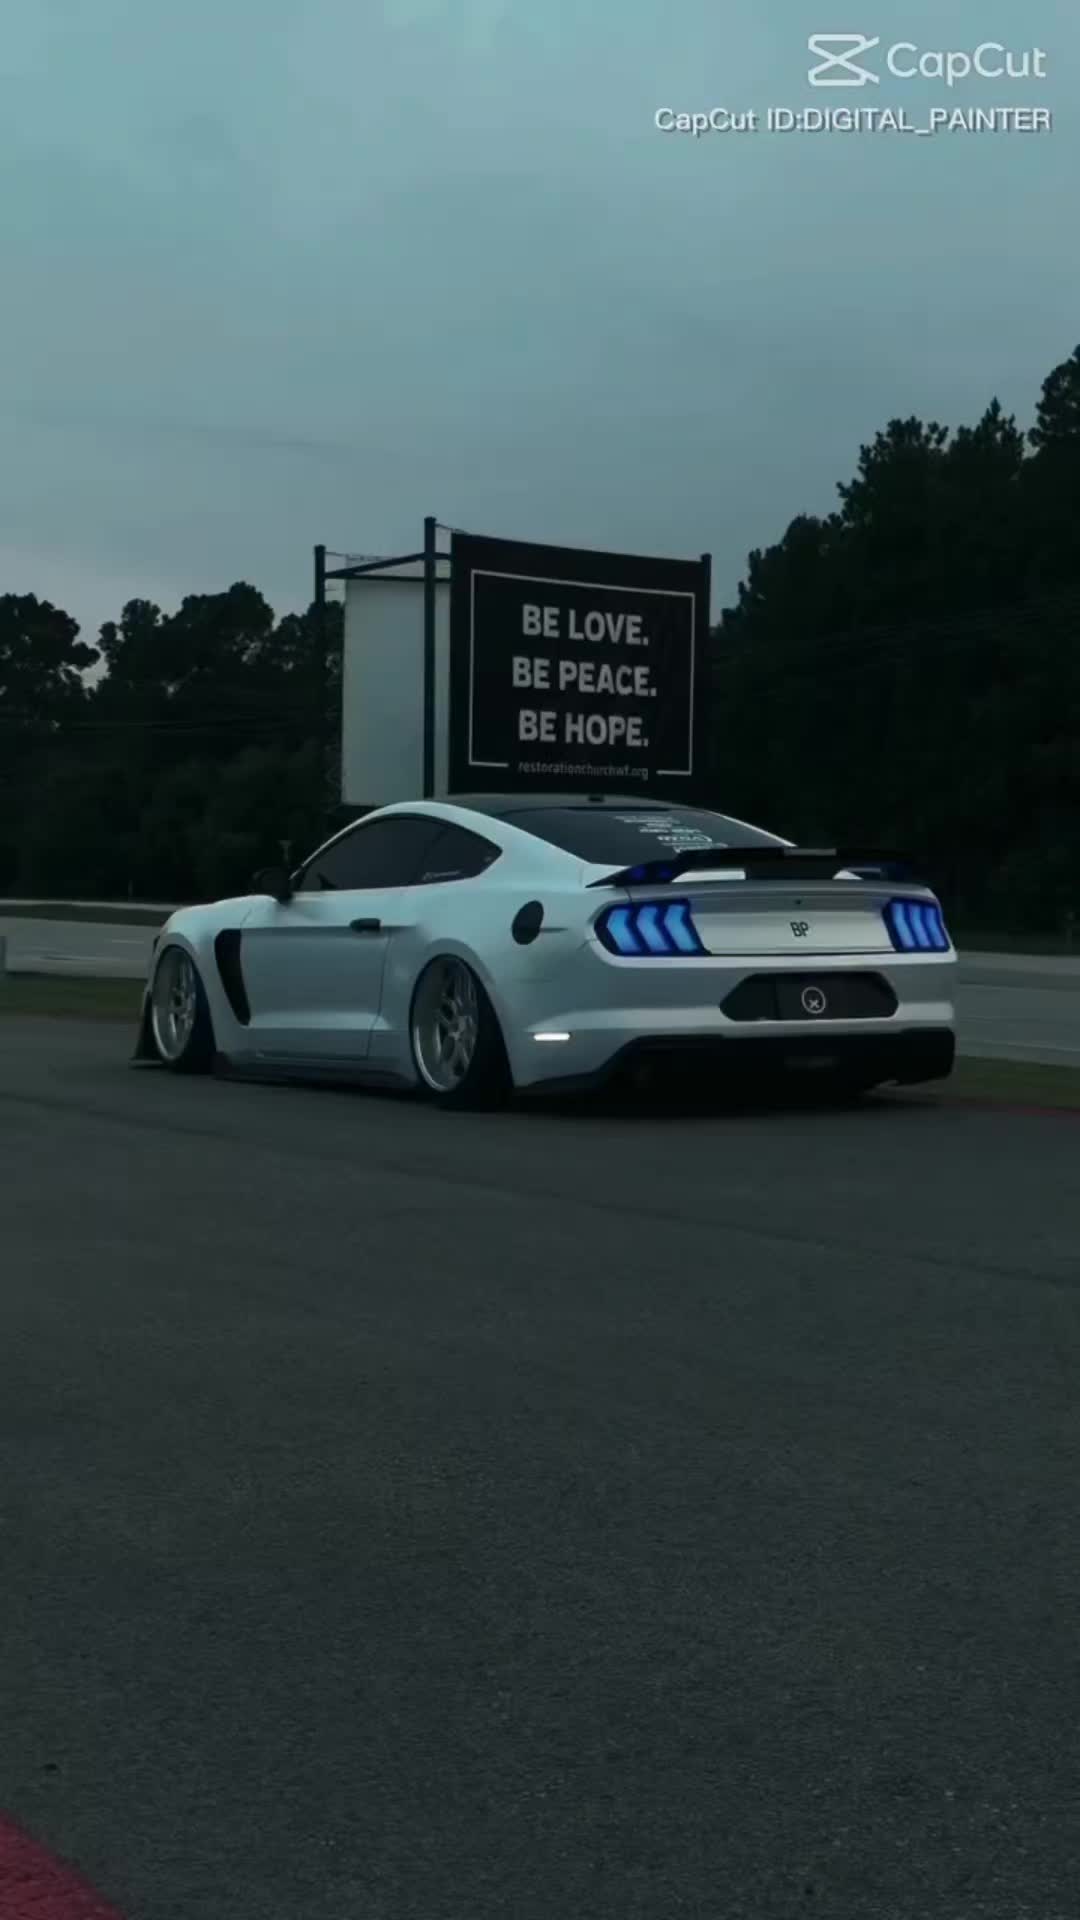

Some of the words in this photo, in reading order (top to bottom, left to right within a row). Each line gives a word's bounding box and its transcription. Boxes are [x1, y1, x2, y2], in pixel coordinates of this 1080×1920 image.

[521, 603, 561, 639] BE
[567, 608, 650, 646] LOVE.
[511, 655, 551, 690] BE
[558, 660, 657, 697] PEACE.
[518, 709, 557, 743] BE
[564, 713, 649, 748] HOPE.
